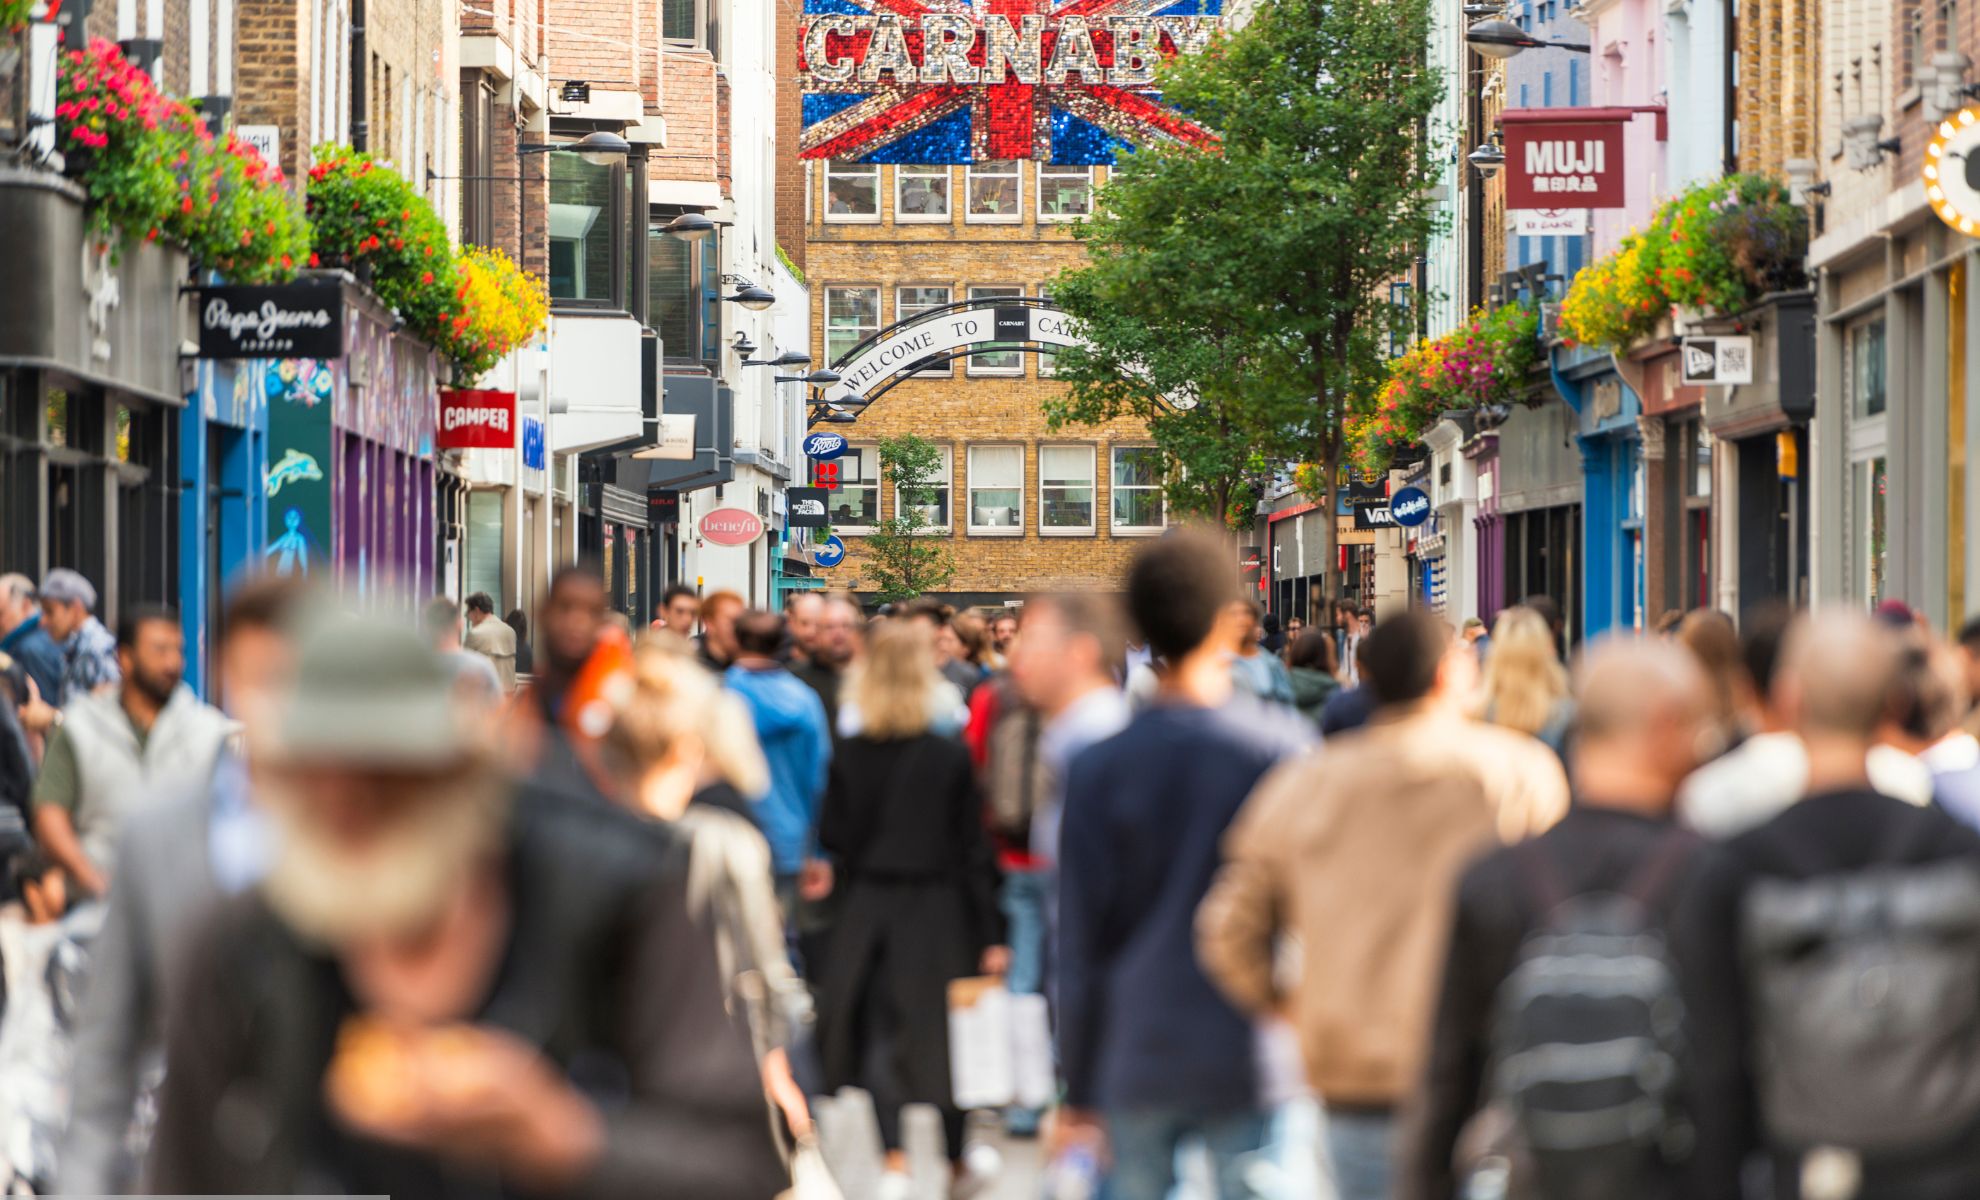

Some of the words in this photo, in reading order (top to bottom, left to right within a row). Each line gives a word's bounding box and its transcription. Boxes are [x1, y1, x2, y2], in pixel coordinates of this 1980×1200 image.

[803, 12, 1219, 83] CARNABY
[1524, 140, 1605, 174] MUJI
[204, 297, 260, 340] Pepe
[257, 300, 332, 340] Jeans
[843, 331, 935, 392] WELCOME
[951, 320, 978, 338] TO
[445, 407, 509, 432] CAMPER
[807, 437, 842, 455] Boots
[704, 519, 757, 535] benefit
[1365, 508, 1396, 523] VAN
